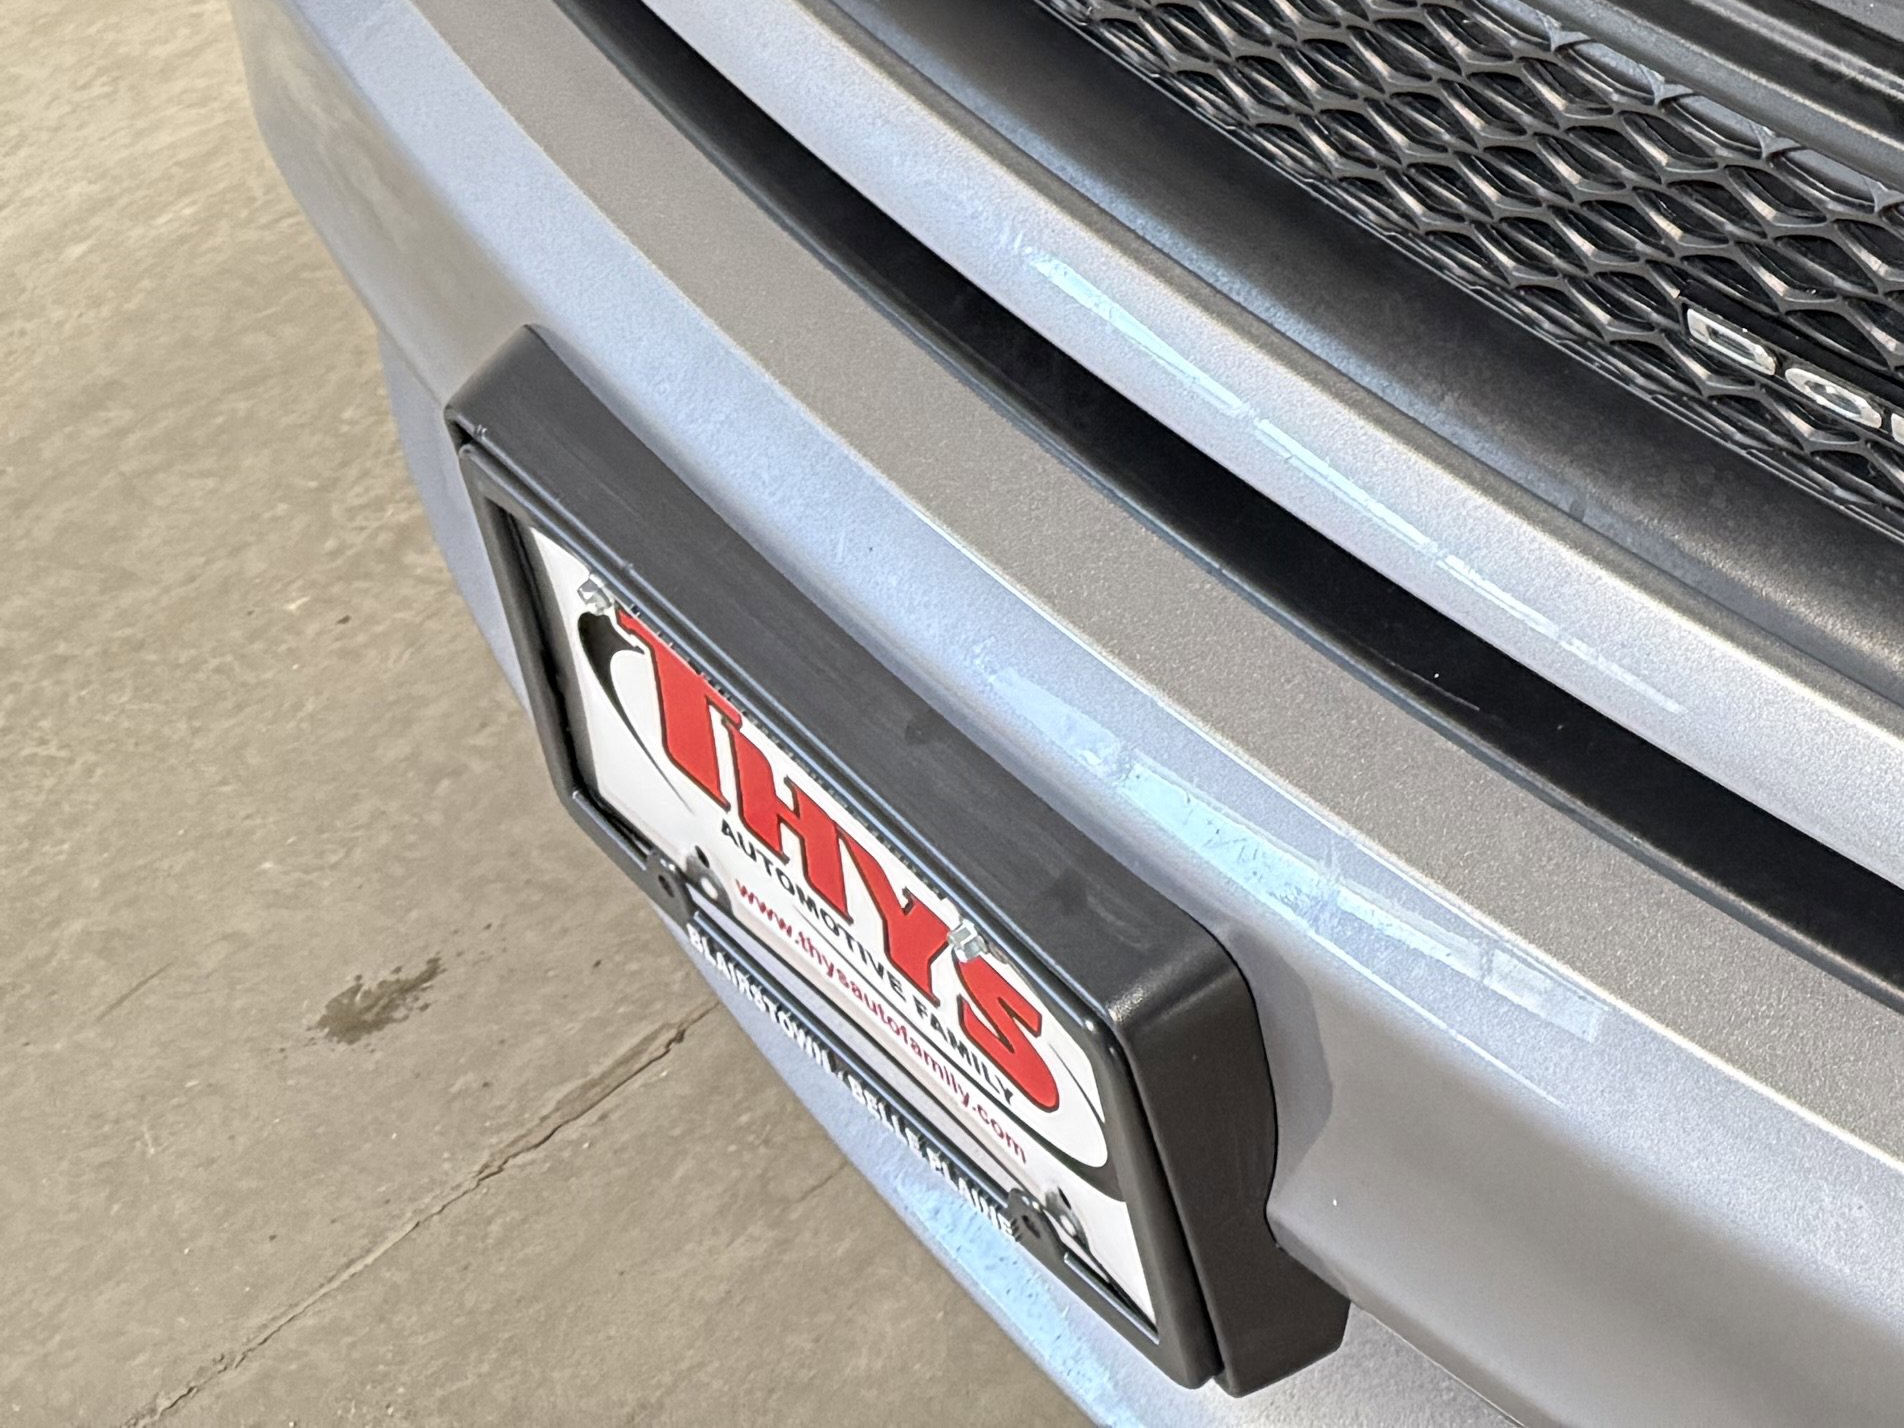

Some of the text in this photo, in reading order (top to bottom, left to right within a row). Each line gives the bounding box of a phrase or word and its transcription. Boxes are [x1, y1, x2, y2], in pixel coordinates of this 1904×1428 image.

[619, 608, 1059, 1113] THYS
[720, 818, 1015, 1106] AUTOMOTIVE FAMILY
[735, 878, 1027, 1165] www.thysautofamily.com
